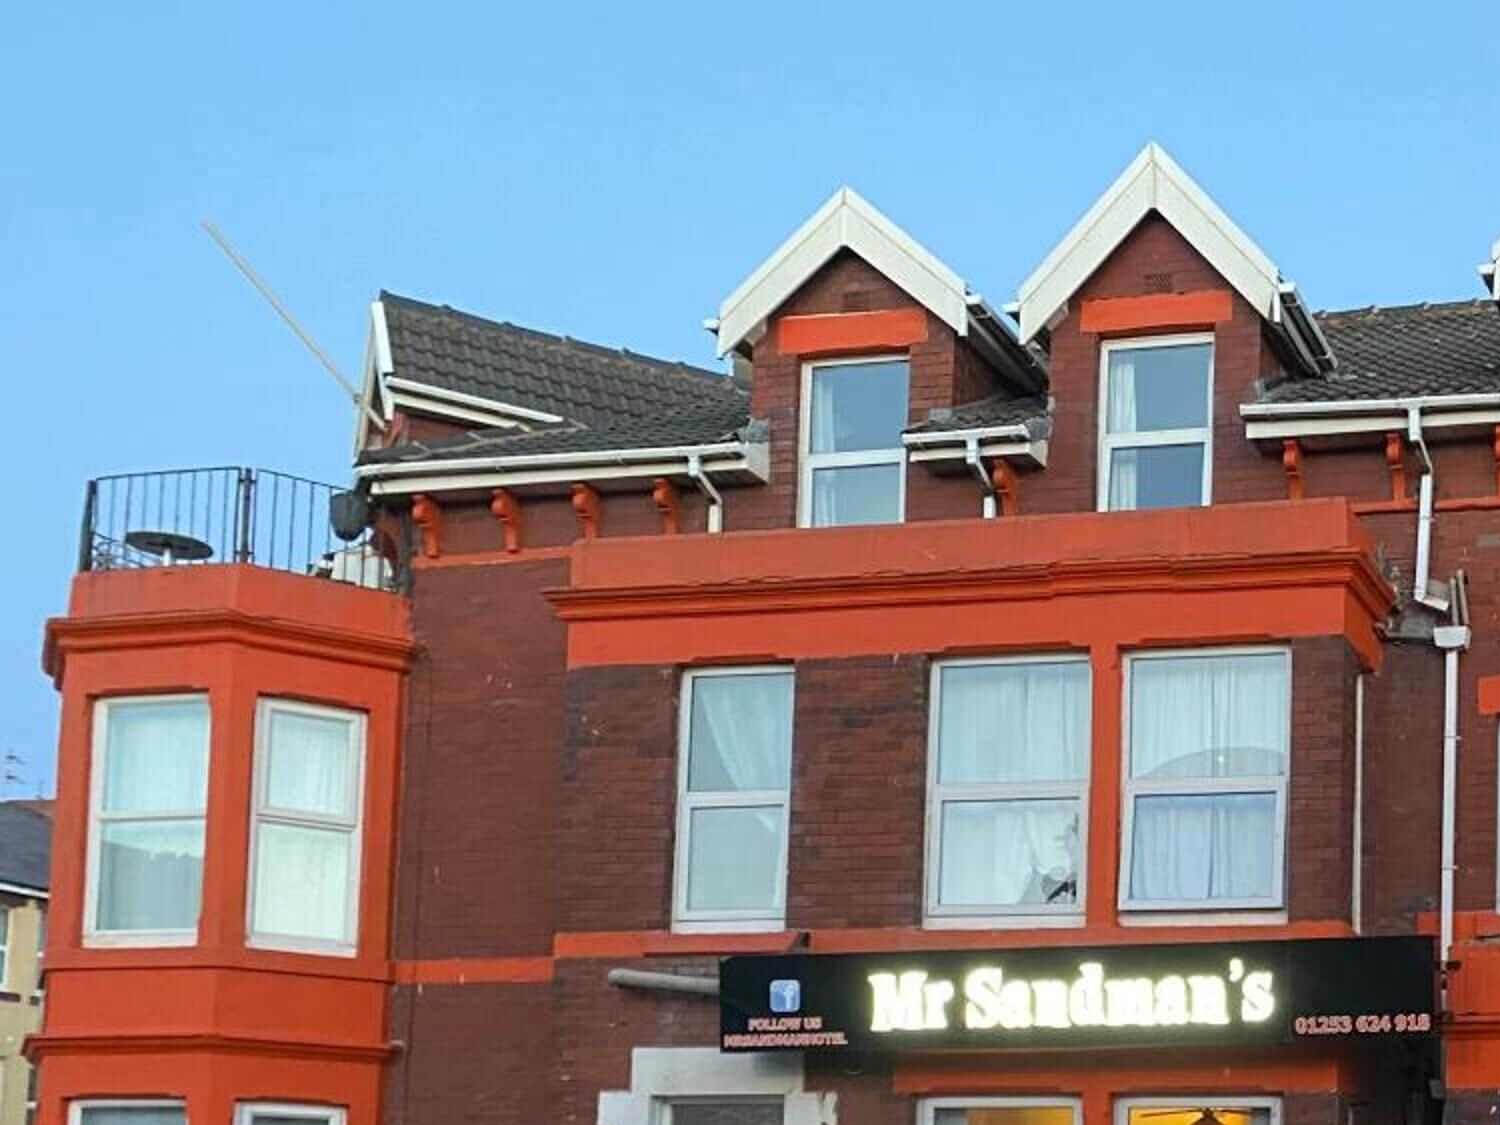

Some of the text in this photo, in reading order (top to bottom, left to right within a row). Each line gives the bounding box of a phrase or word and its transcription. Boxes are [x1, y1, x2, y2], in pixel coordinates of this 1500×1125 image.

[867, 957, 1275, 1032] Mr Sandman's
[748, 1017, 822, 1031] FOLLOW US
